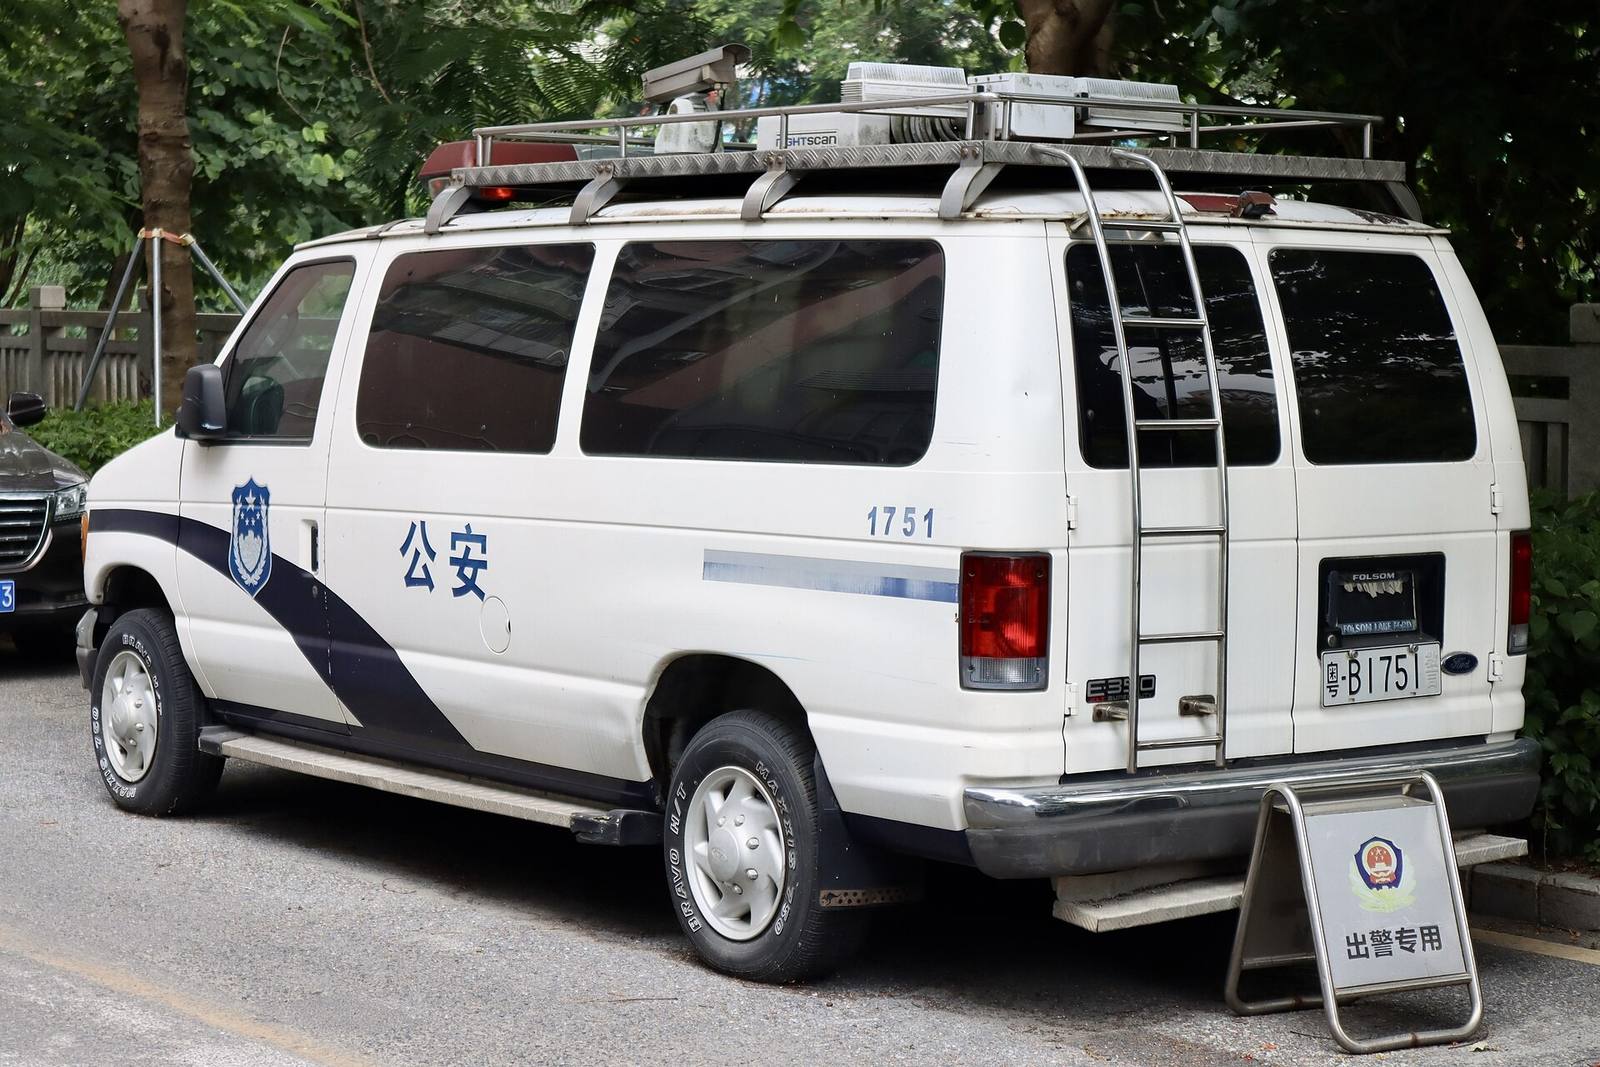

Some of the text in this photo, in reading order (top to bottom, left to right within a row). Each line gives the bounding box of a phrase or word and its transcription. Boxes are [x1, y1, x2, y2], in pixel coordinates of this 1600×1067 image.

[867, 506, 934, 538] 1751
[399, 520, 488, 602] 公安
[1352, 572, 1395, 581] FOLSOM
[1343, 623, 1372, 633] FOLSOM
[755, 760, 796, 871] MAXXIS
[670, 781, 702, 933] BRAVO H/T
[1345, 924, 1443, 960] 出警专用
